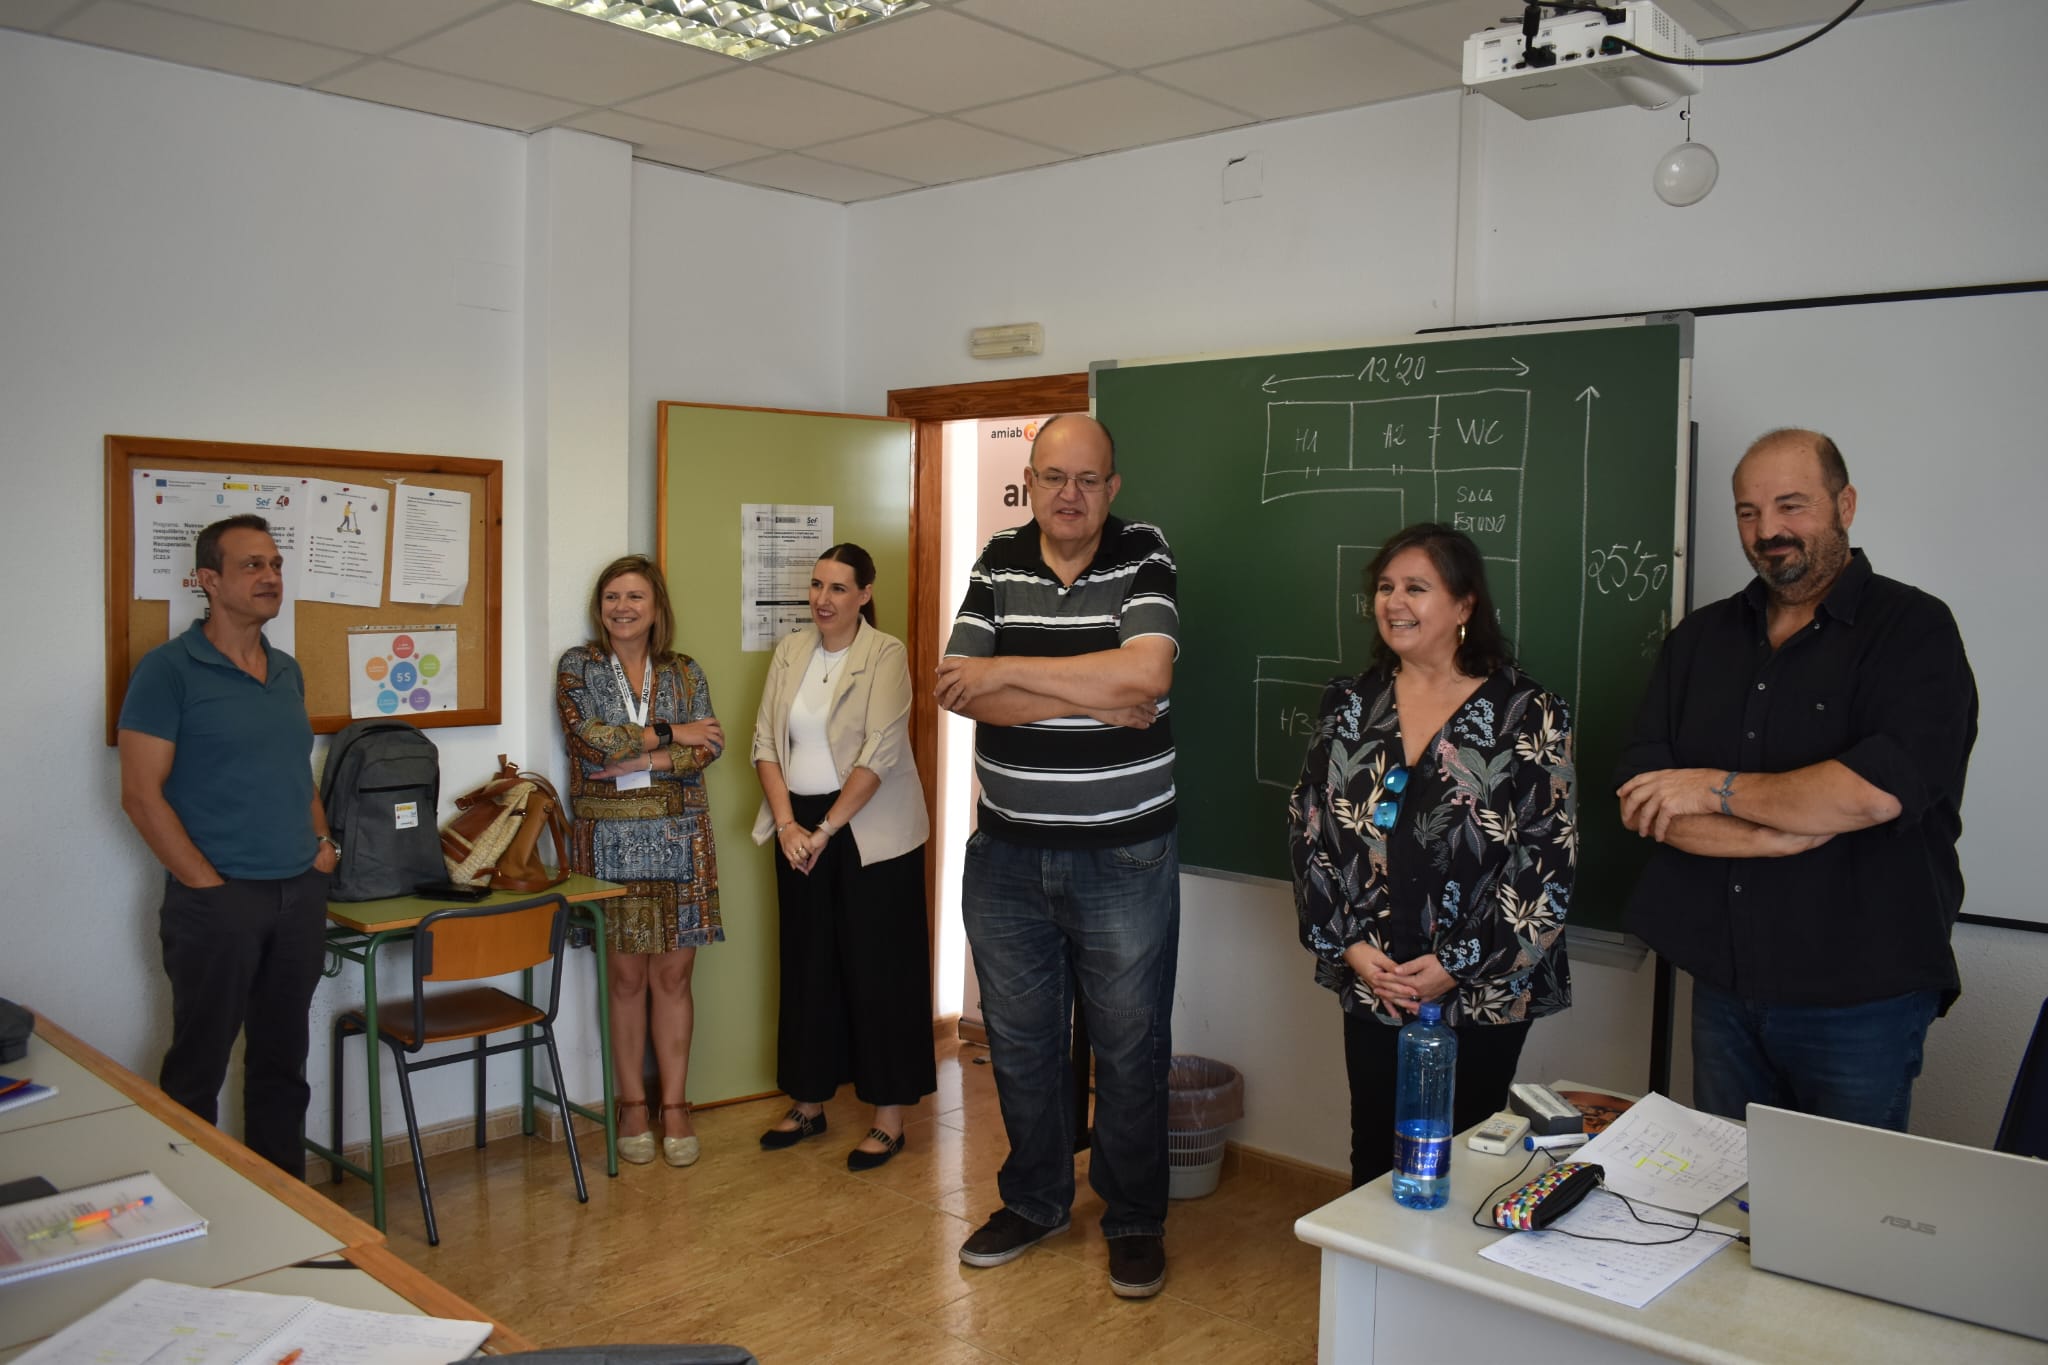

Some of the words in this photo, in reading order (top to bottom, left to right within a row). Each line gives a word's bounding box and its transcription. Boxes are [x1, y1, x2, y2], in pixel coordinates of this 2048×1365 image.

[991, 427, 1023, 439] amiab
[1456, 417, 1504, 445] WC
[1880, 1215, 1937, 1235] ASUS
